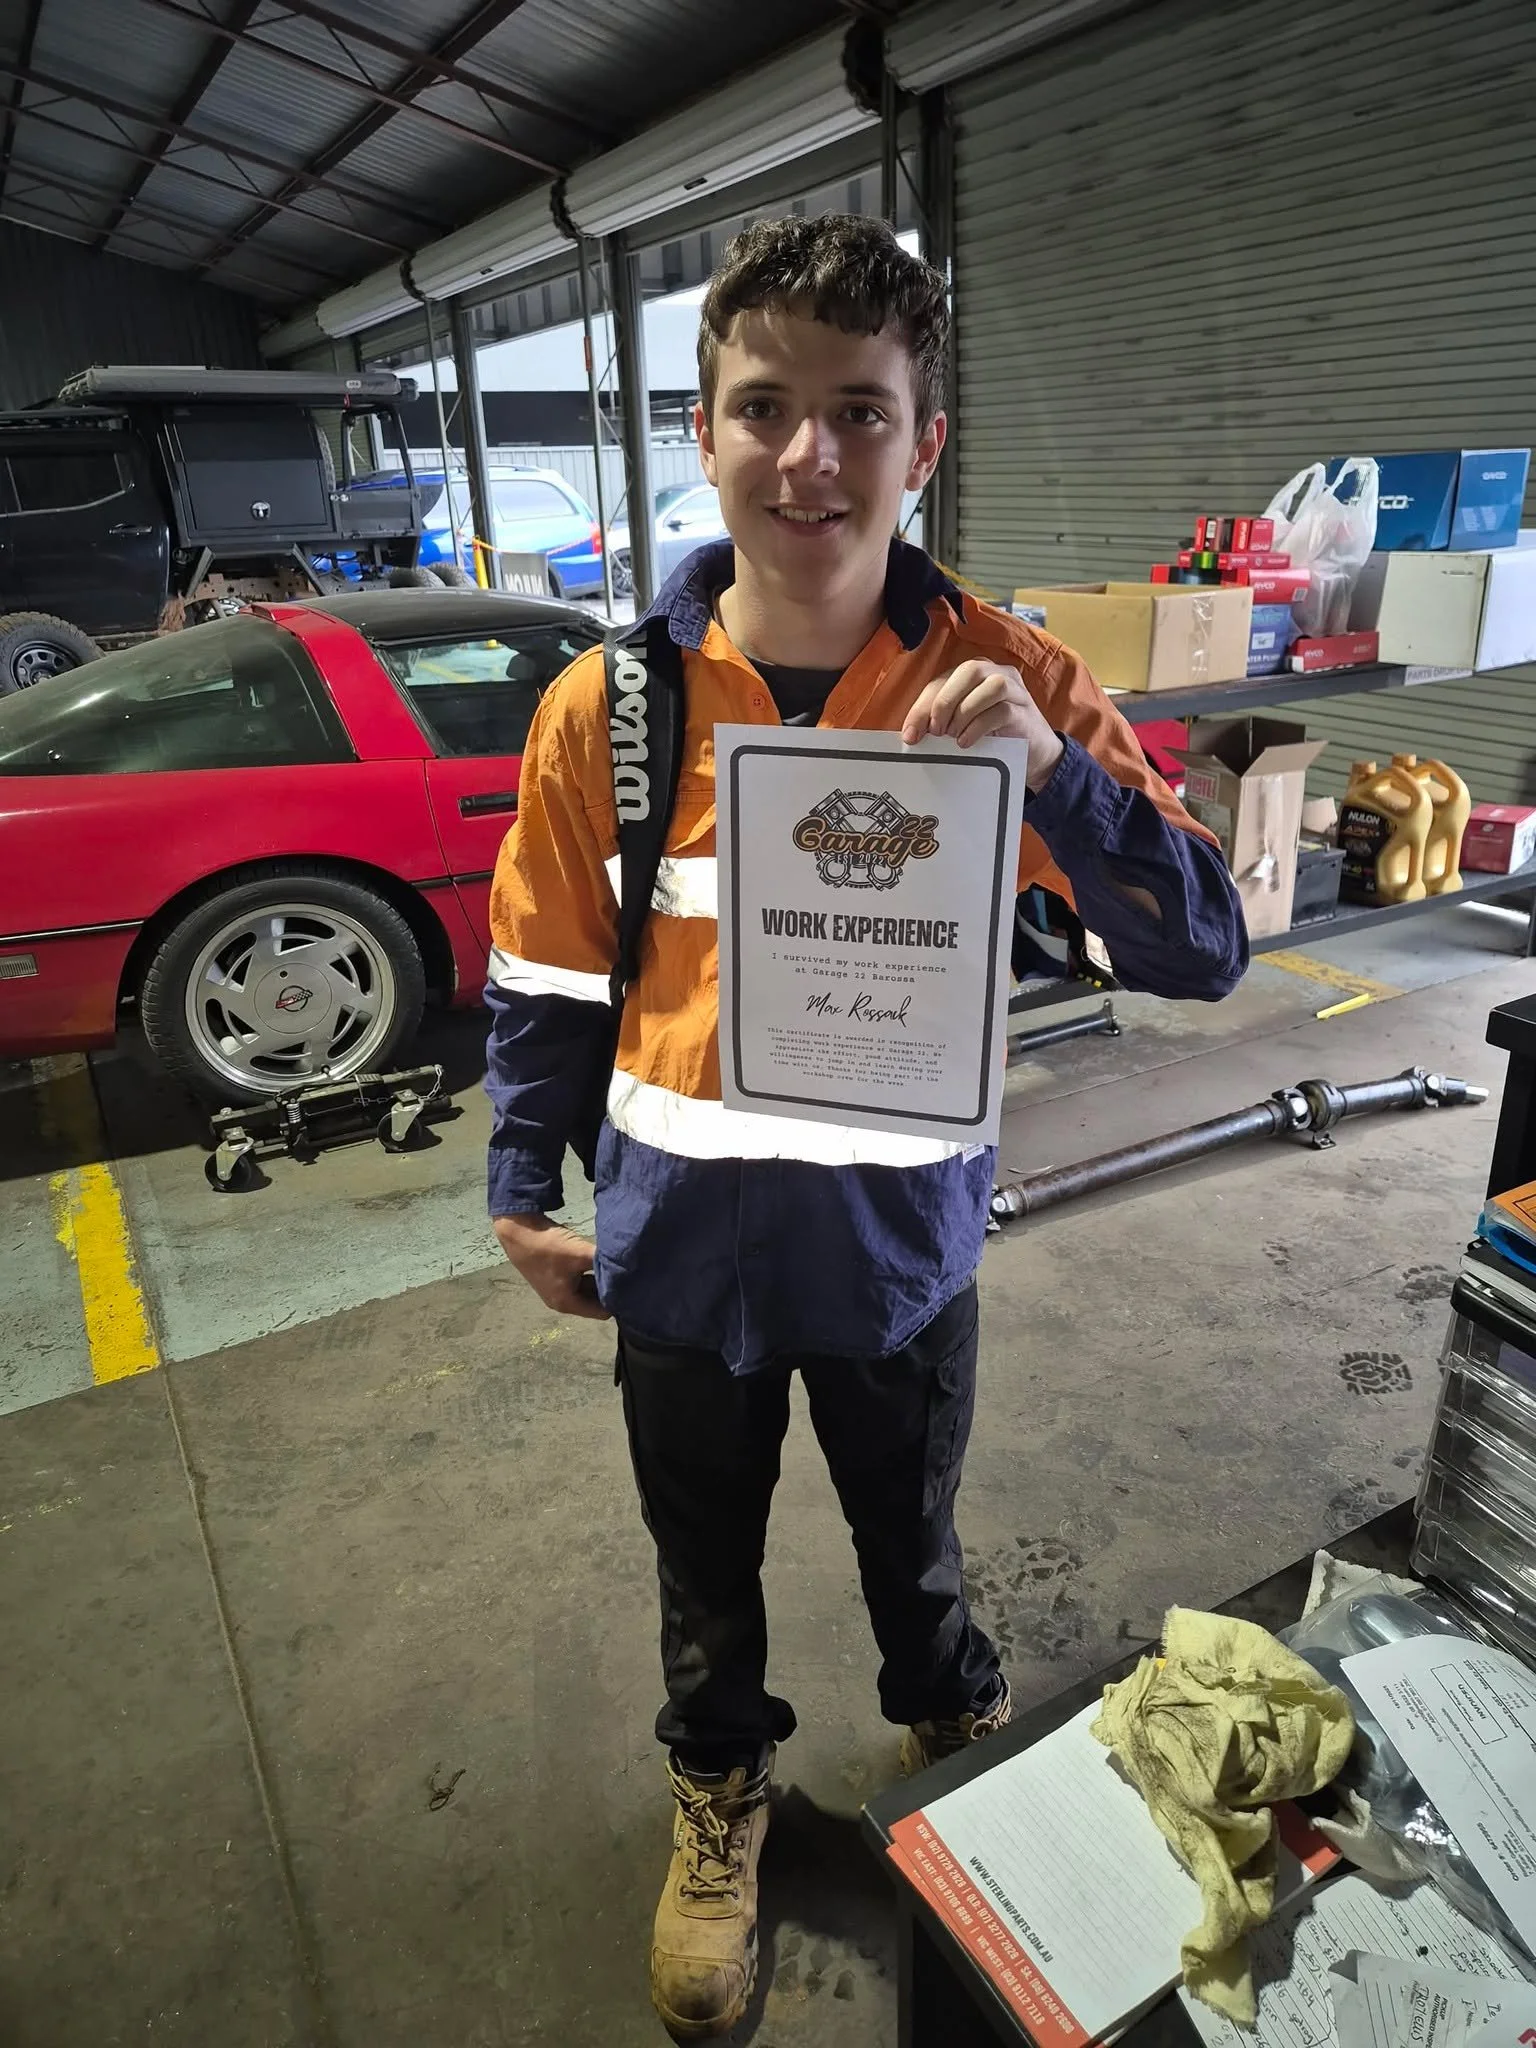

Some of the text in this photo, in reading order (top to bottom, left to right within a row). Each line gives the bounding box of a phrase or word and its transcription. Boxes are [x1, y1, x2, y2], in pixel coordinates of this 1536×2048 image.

[609, 629, 651, 826] Wilson
[1348, 811, 1381, 824] NULON
[792, 814, 940, 867] Garage 22
[859, 853, 887, 866] 2022
[761, 906, 959, 950] WORK EXPERIENCE
[783, 953, 830, 964] survived
[854, 960, 878, 968] work
[885, 962, 946, 974] experience
[812, 968, 847, 978] Garage
[872, 973, 915, 983] Barossa
[807, 992, 843, 1019] Max
[771, 1036, 810, 1045] completing
[833, 1042, 873, 1051] experience
[888, 1047, 913, 1055] Garage
[786, 1029, 829, 1038] certificate
[889, 1039, 934, 1048] recognition
[769, 1051, 811, 1061] willingness
[898, 1065, 922, 1073] during
[802, 1070, 833, 1078] workshop
[912, 1847, 926, 1861] VIC
[920, 1858, 938, 1878] EAST:
[975, 1934, 990, 1950] VIC
[983, 1946, 1006, 1971] WEST:
[969, 1856, 1054, 1964] WWW.STERLINGPARTS.COM.AU
[986, 1920, 1005, 1941] 3277
